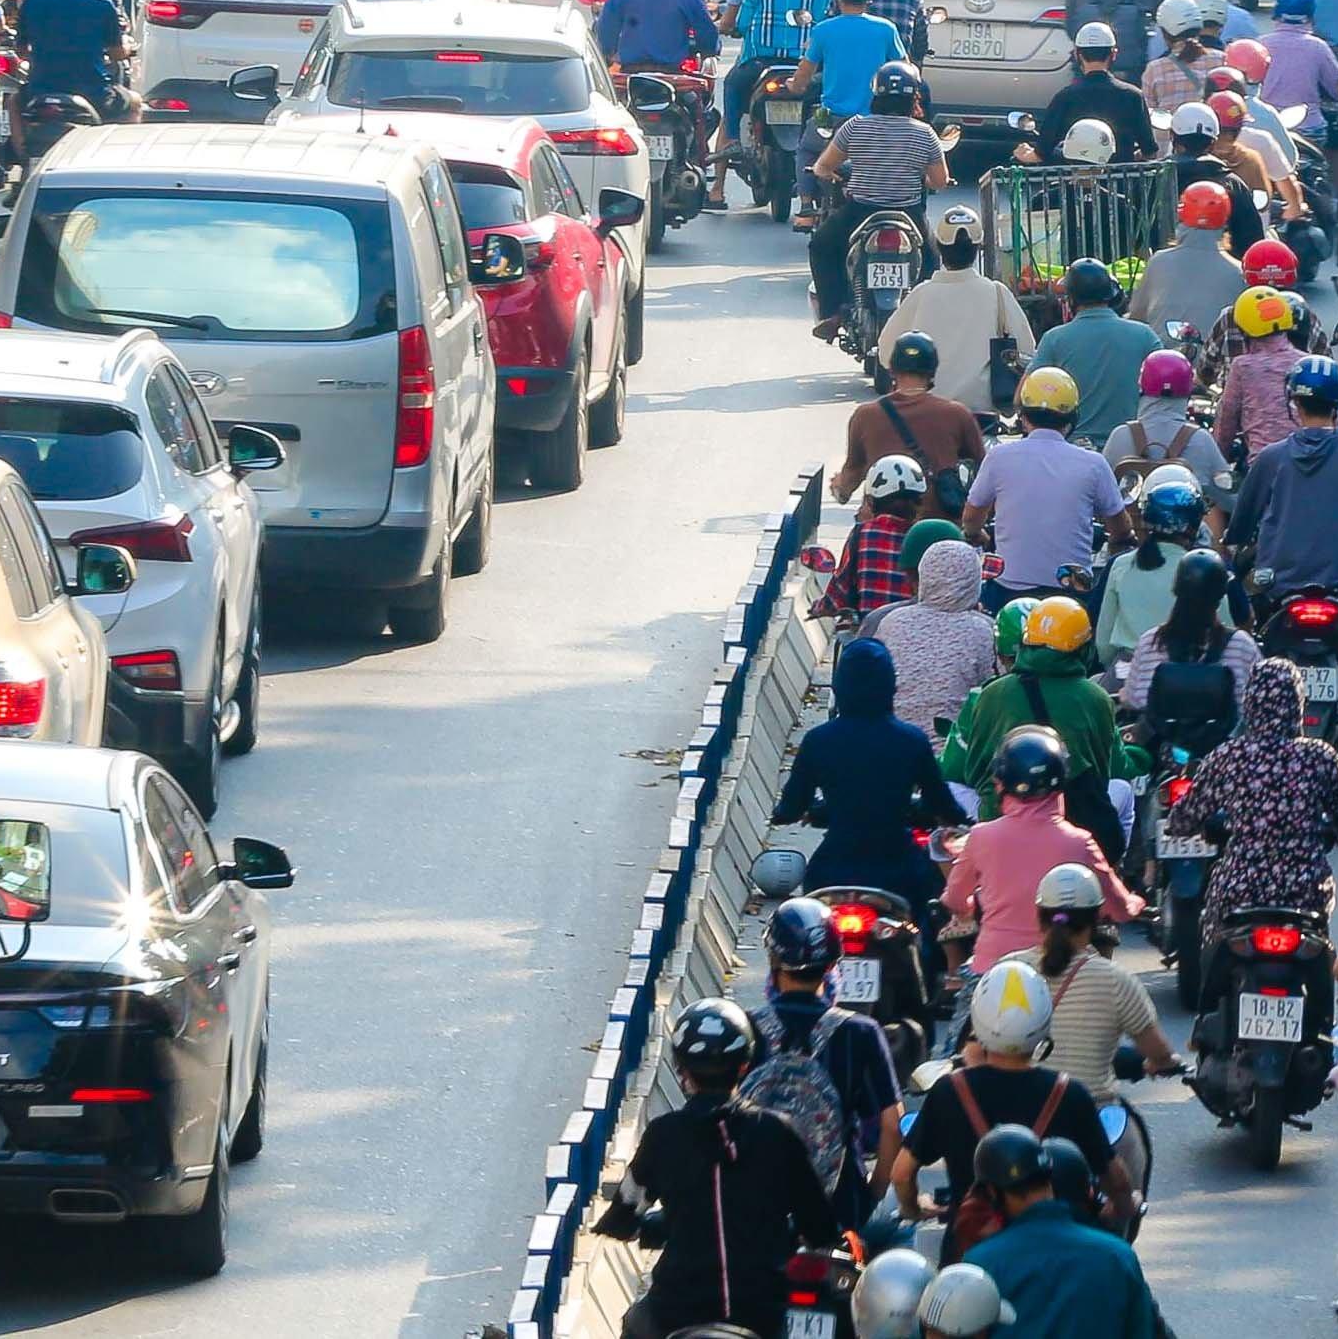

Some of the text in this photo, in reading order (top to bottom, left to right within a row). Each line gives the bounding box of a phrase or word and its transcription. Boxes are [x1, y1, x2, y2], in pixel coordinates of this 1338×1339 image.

[967, 23, 993, 38] 19A
[873, 264, 903, 275] 29-X1
[1301, 669, 1330, 683] 9-X7
[1307, 685, 1334, 699] 1.76
[1251, 998, 1295, 1018] 18-B2
[1242, 1018, 1300, 1039] 762.17
